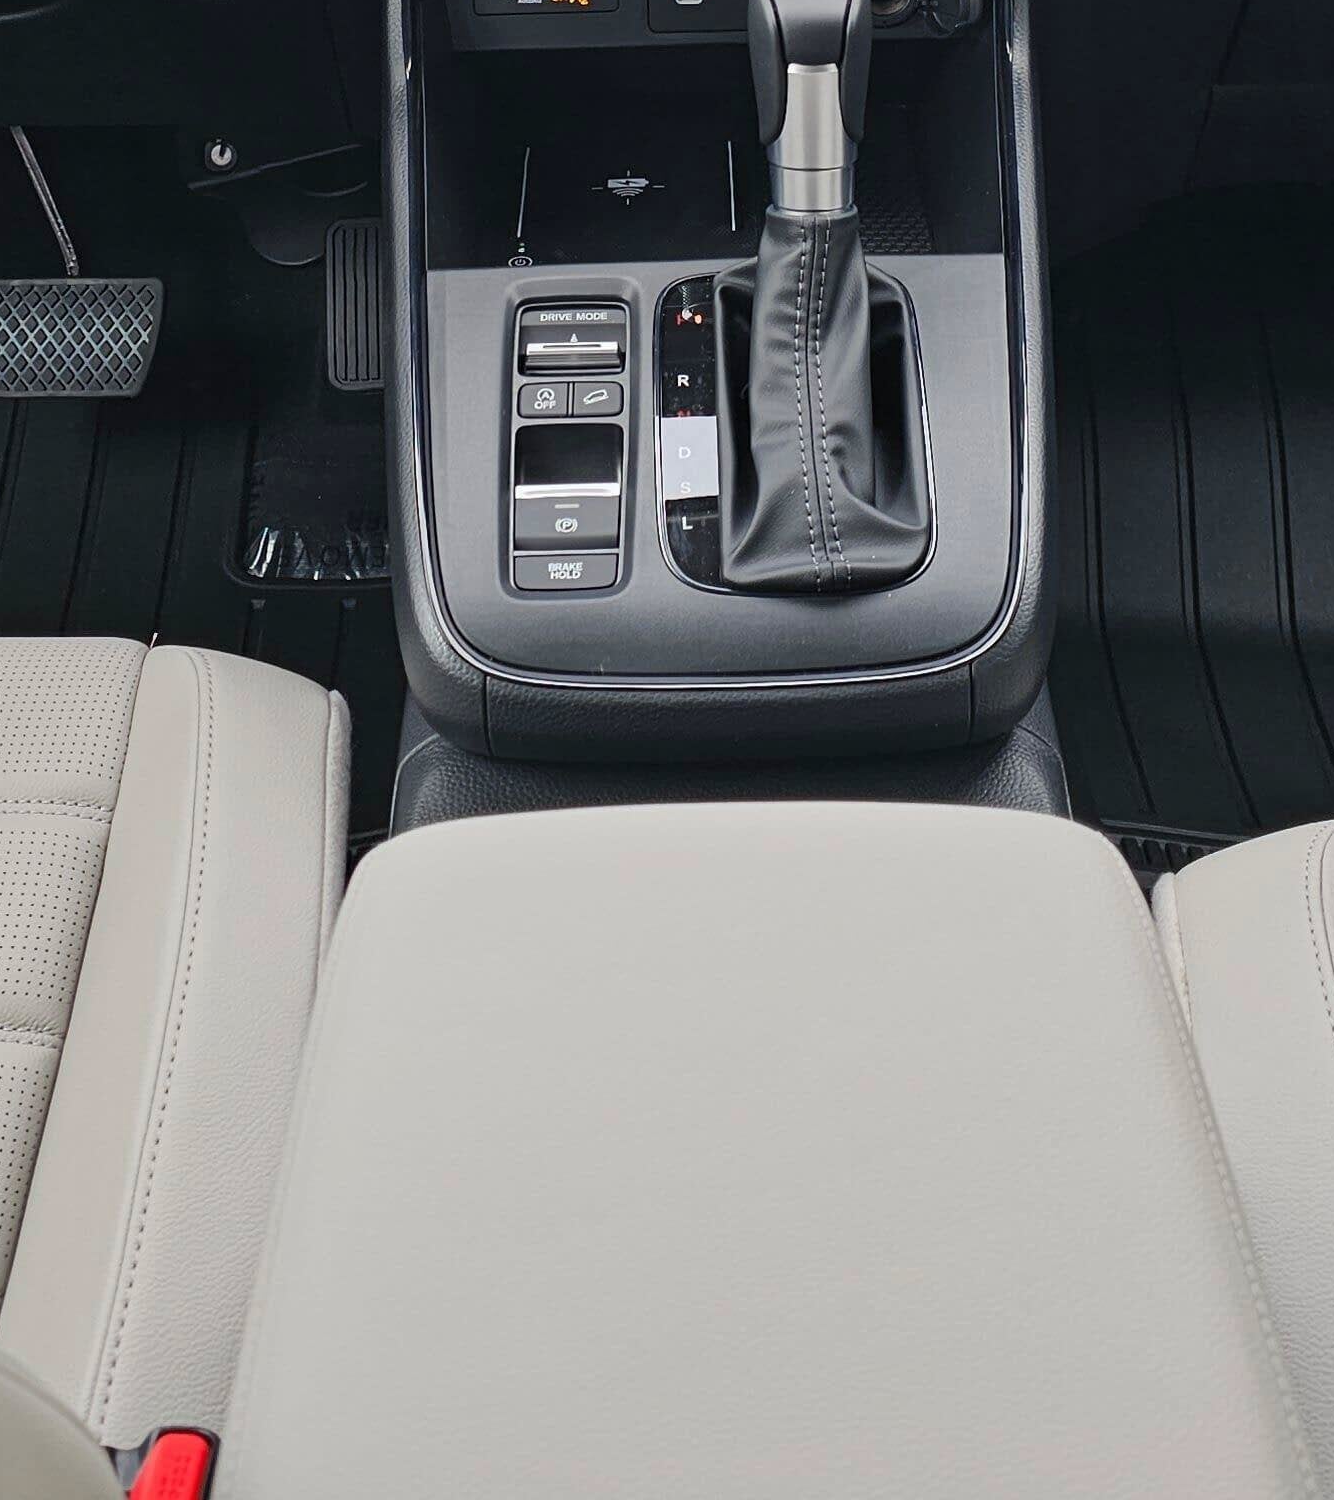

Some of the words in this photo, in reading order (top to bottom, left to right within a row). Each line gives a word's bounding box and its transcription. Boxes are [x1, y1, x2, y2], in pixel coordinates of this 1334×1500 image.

[540, 313, 573, 322] DRIVE
[575, 312, 608, 321] MODE
[677, 374, 690, 387] R
[534, 400, 557, 410] OFF
[678, 446, 692, 459] D
[680, 482, 692, 494] S
[681, 516, 694, 531] L
[548, 562, 584, 572] BRAKE
[550, 570, 581, 580] HOLD
